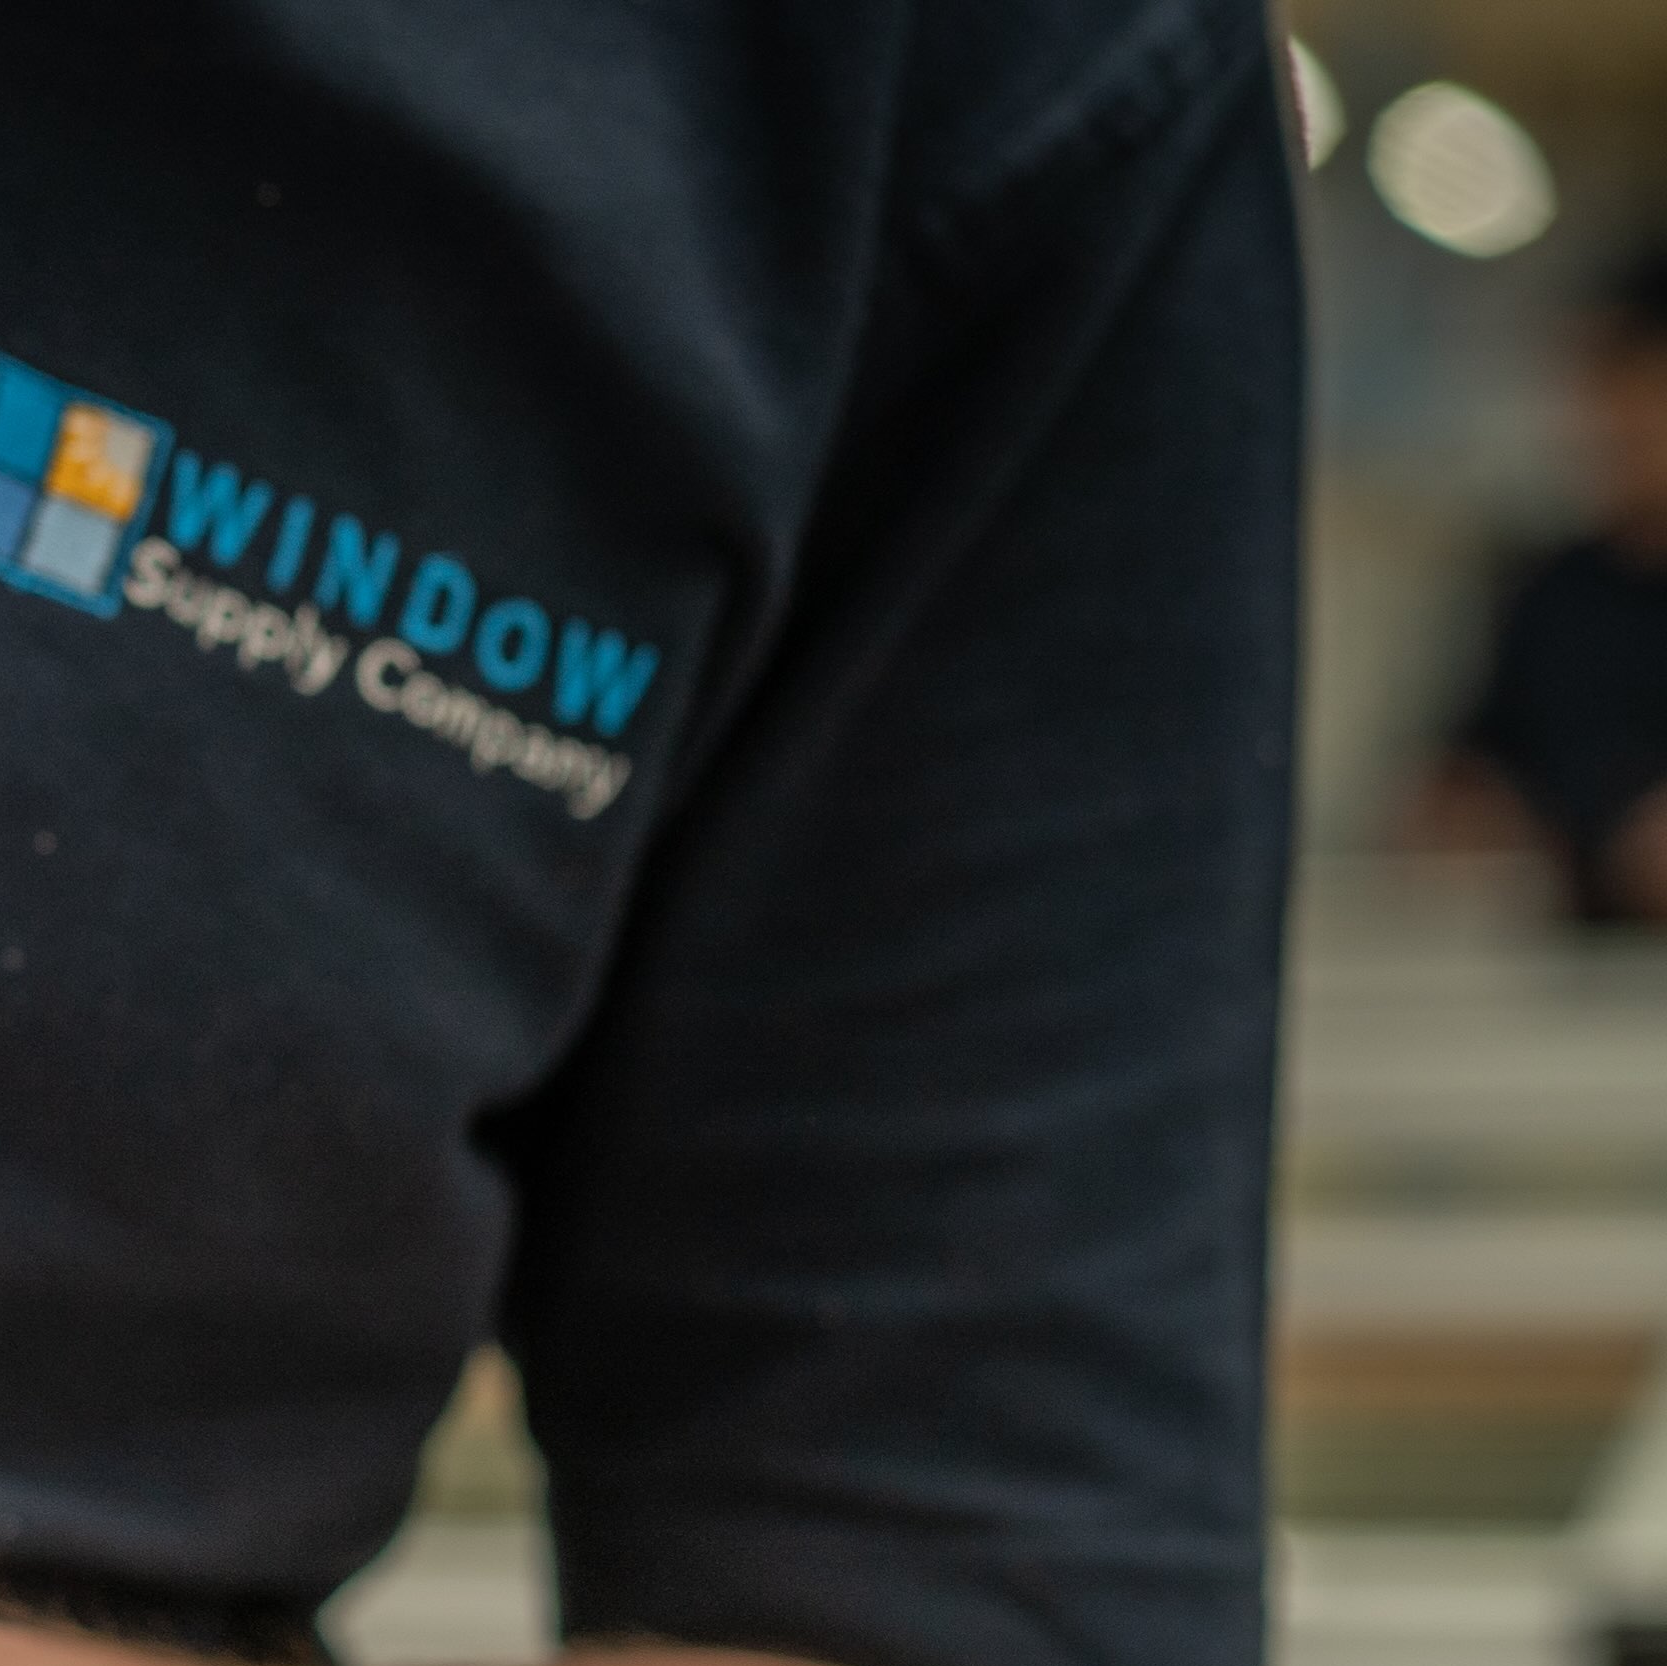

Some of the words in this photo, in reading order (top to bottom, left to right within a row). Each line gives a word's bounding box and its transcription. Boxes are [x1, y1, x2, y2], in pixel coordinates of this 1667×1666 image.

[124, 534, 350, 696] Supply
[355, 636, 632, 820] Company
[167, 448, 661, 736] WINDOW
